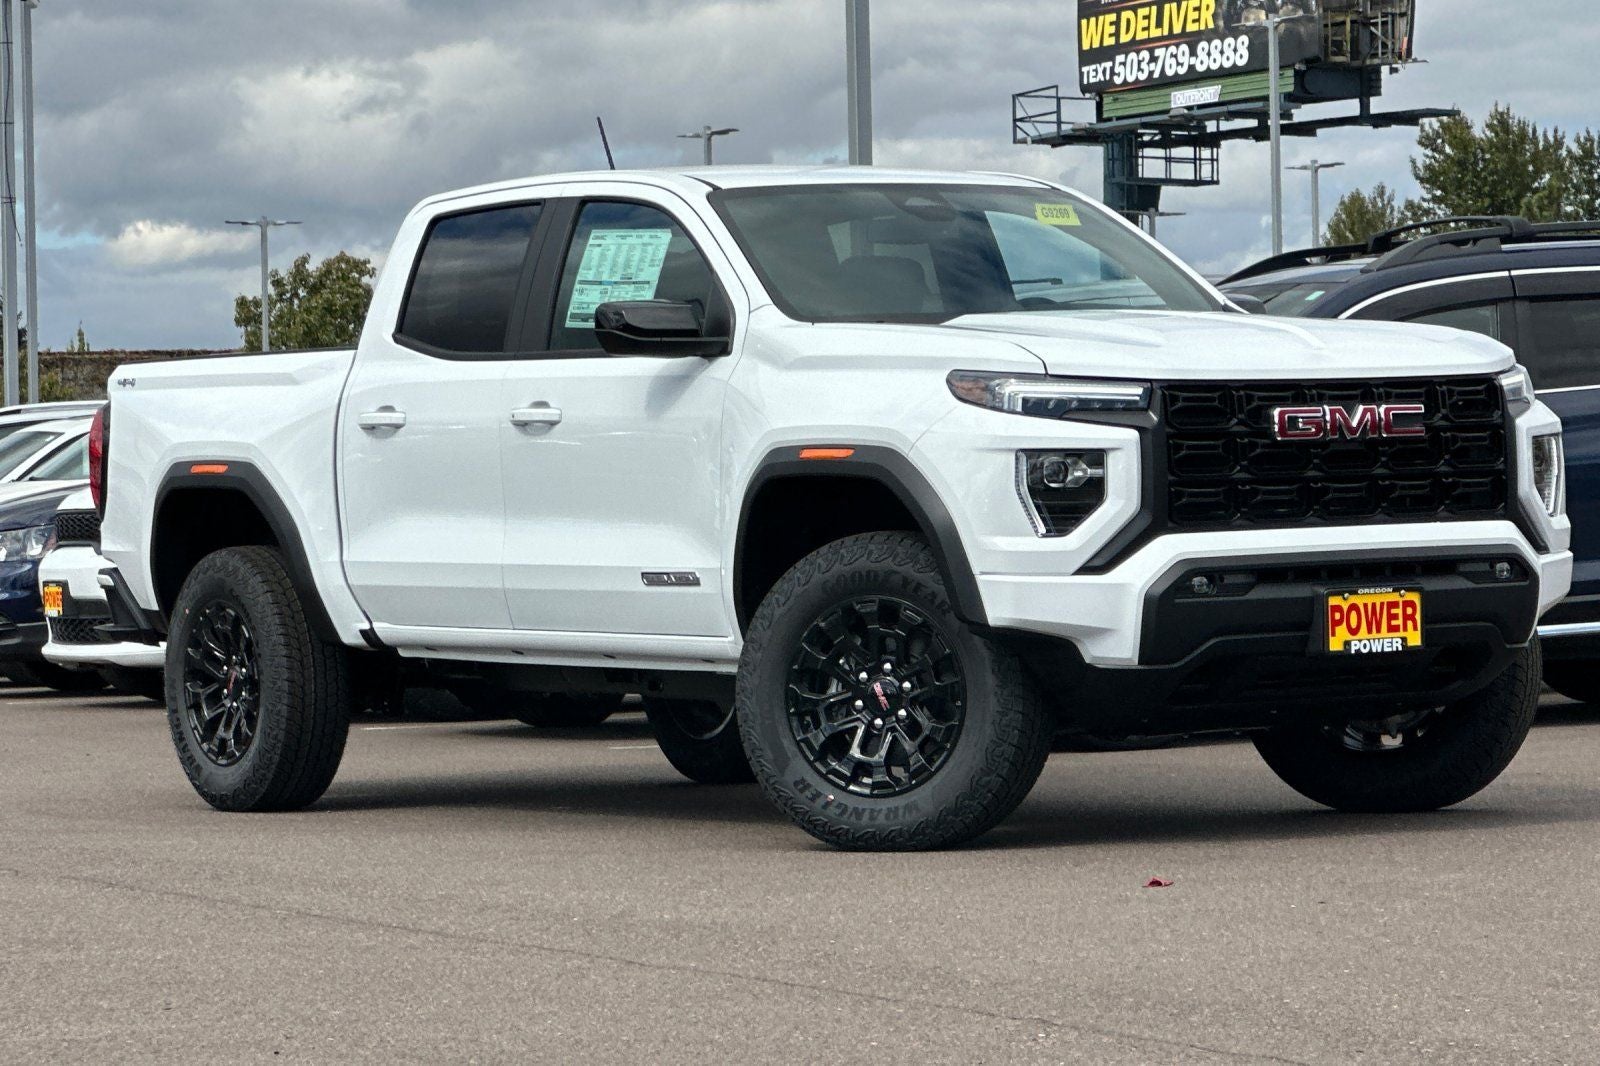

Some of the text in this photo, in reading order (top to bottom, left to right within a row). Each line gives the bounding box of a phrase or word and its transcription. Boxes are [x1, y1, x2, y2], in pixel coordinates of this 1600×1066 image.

[1081, 0, 1216, 50] WE DELIVER
[1081, 34, 1250, 85] TEXT 503-769-8888
[1175, 89, 1215, 104] OUTFRONT
[1273, 404, 1425, 441] GMC
[1329, 599, 1419, 637] POWER
[1350, 637, 1403, 654] POWER
